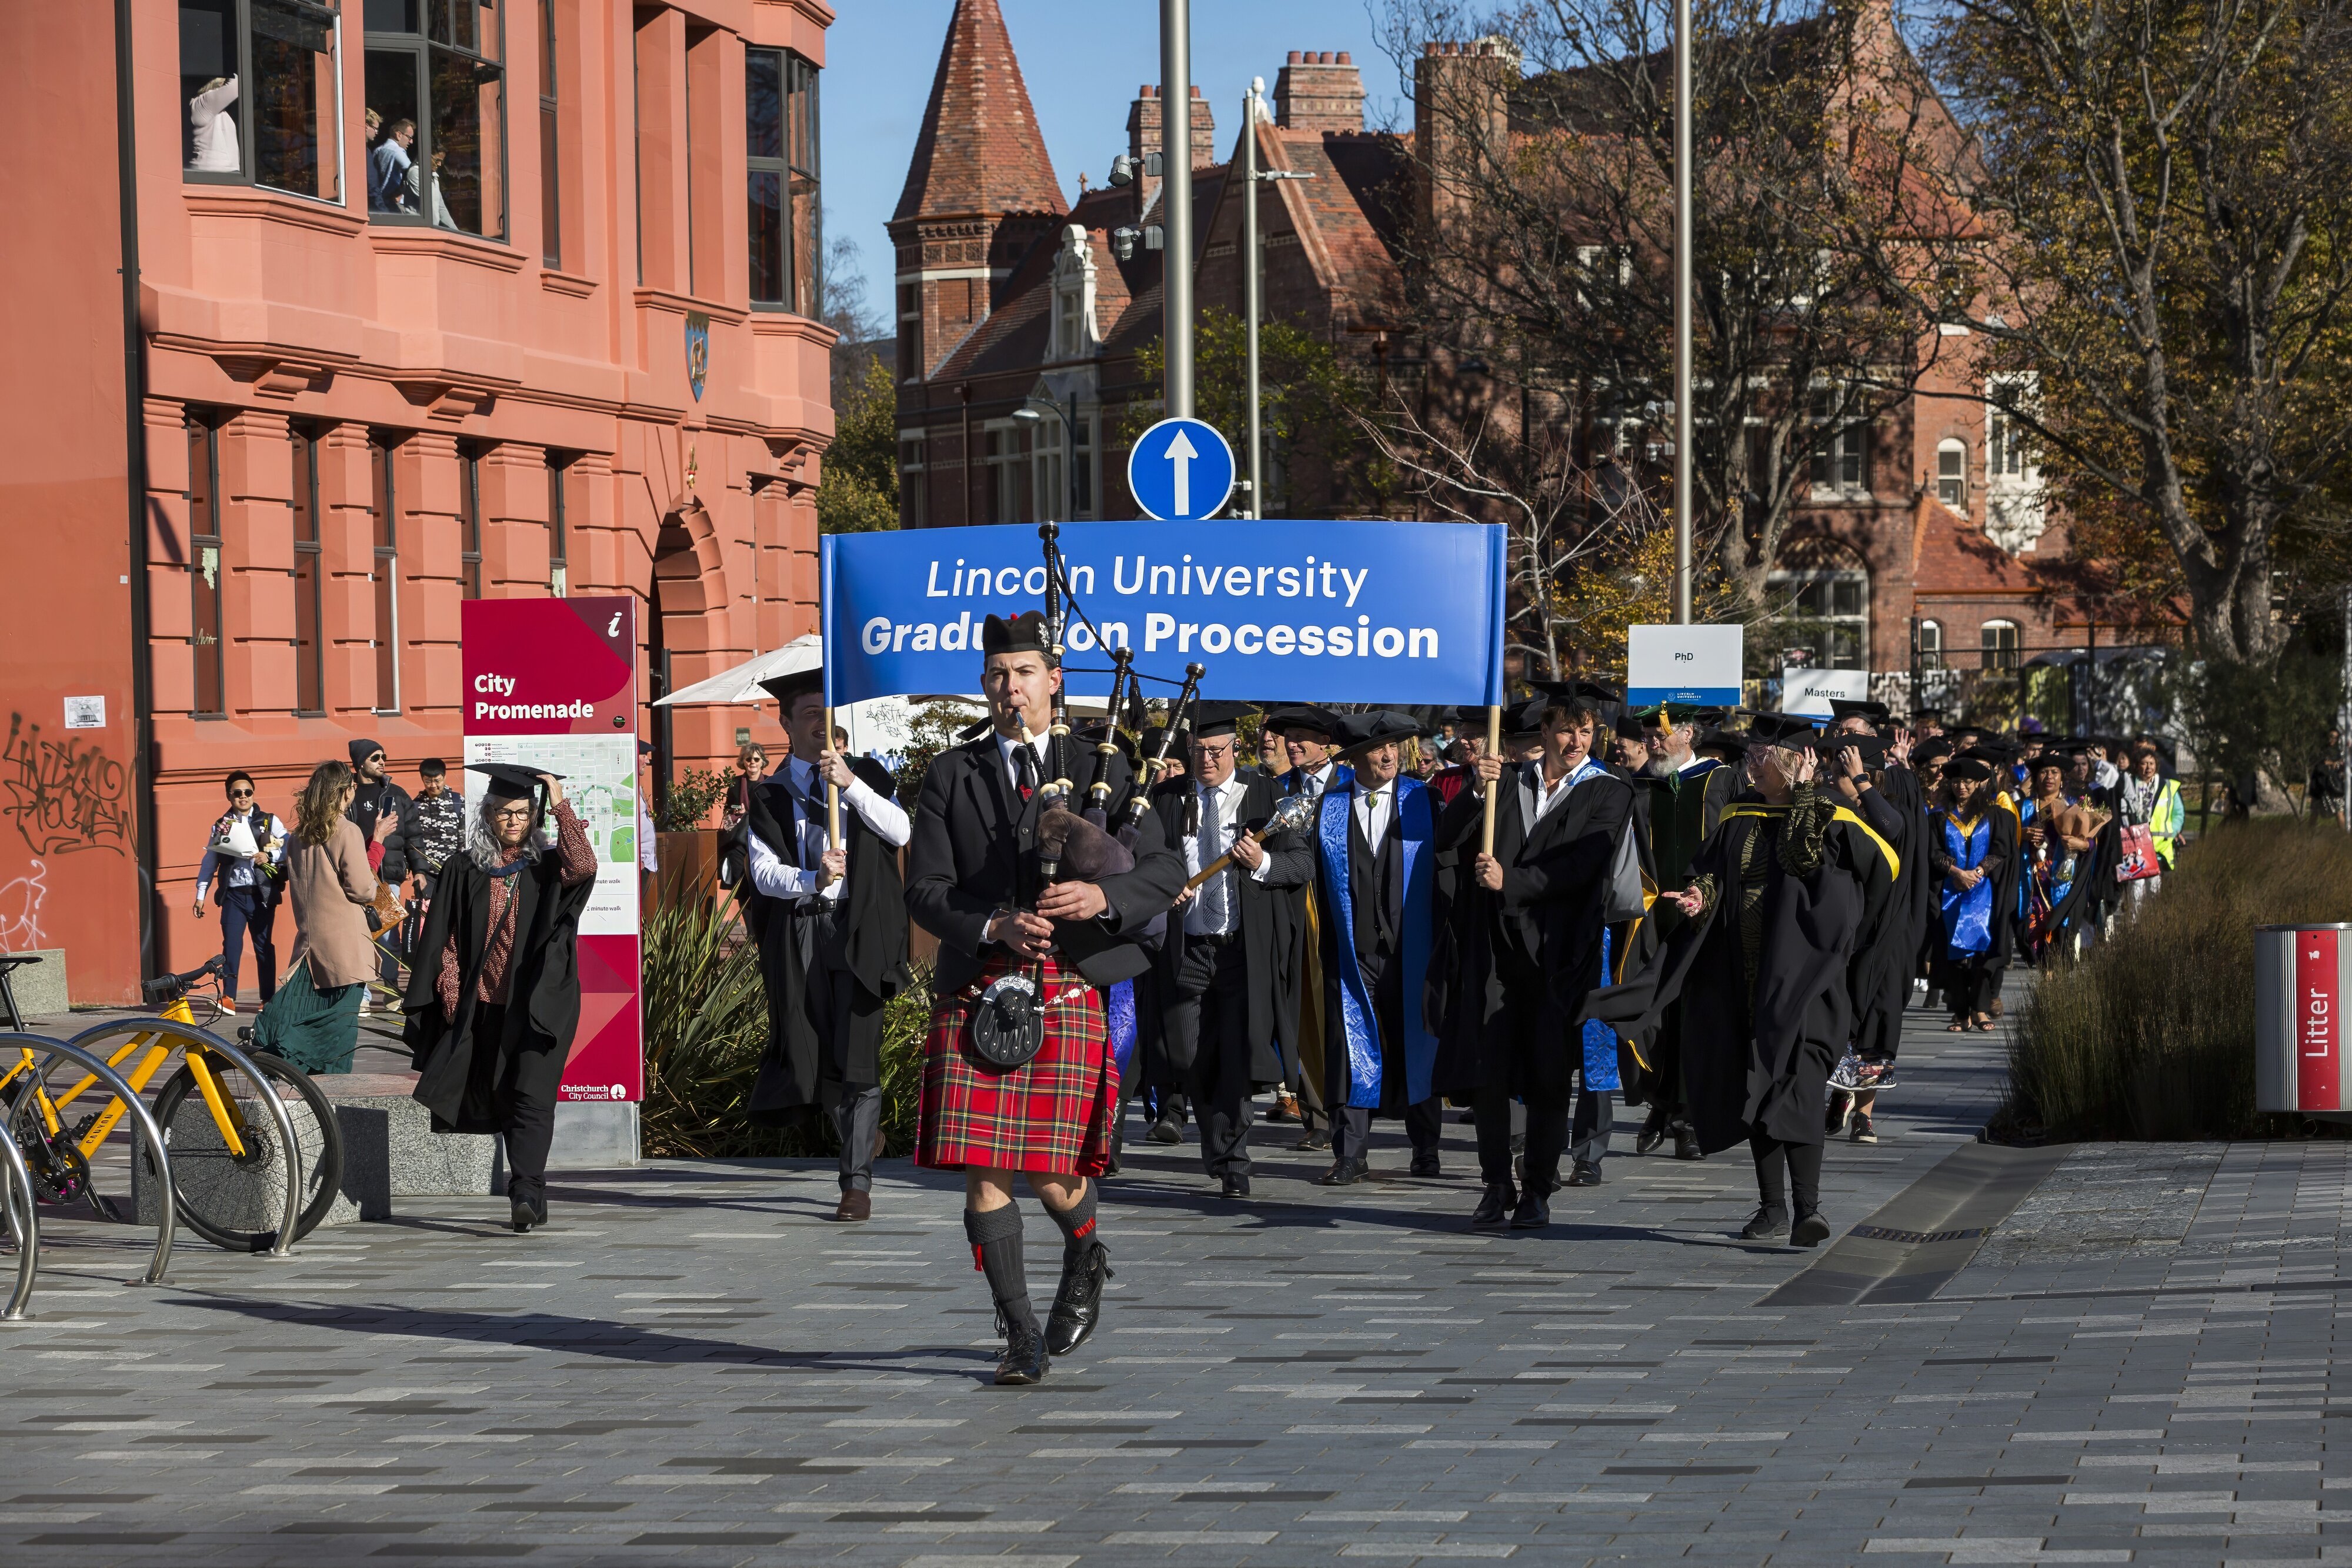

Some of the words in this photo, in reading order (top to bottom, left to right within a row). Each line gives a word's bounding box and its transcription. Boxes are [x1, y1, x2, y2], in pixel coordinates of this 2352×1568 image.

[1114, 555, 1369, 608] University
[1145, 613, 1439, 658] Procession
[1674, 652, 1694, 660] PhD
[474, 673, 516, 697] City
[1804, 688, 1845, 698] Masters
[475, 699, 594, 719] Promenade
[2305, 988, 2328, 1057] Litter
[569, 1092, 582, 1100] City
[86, 1114, 113, 1144] CANYON
